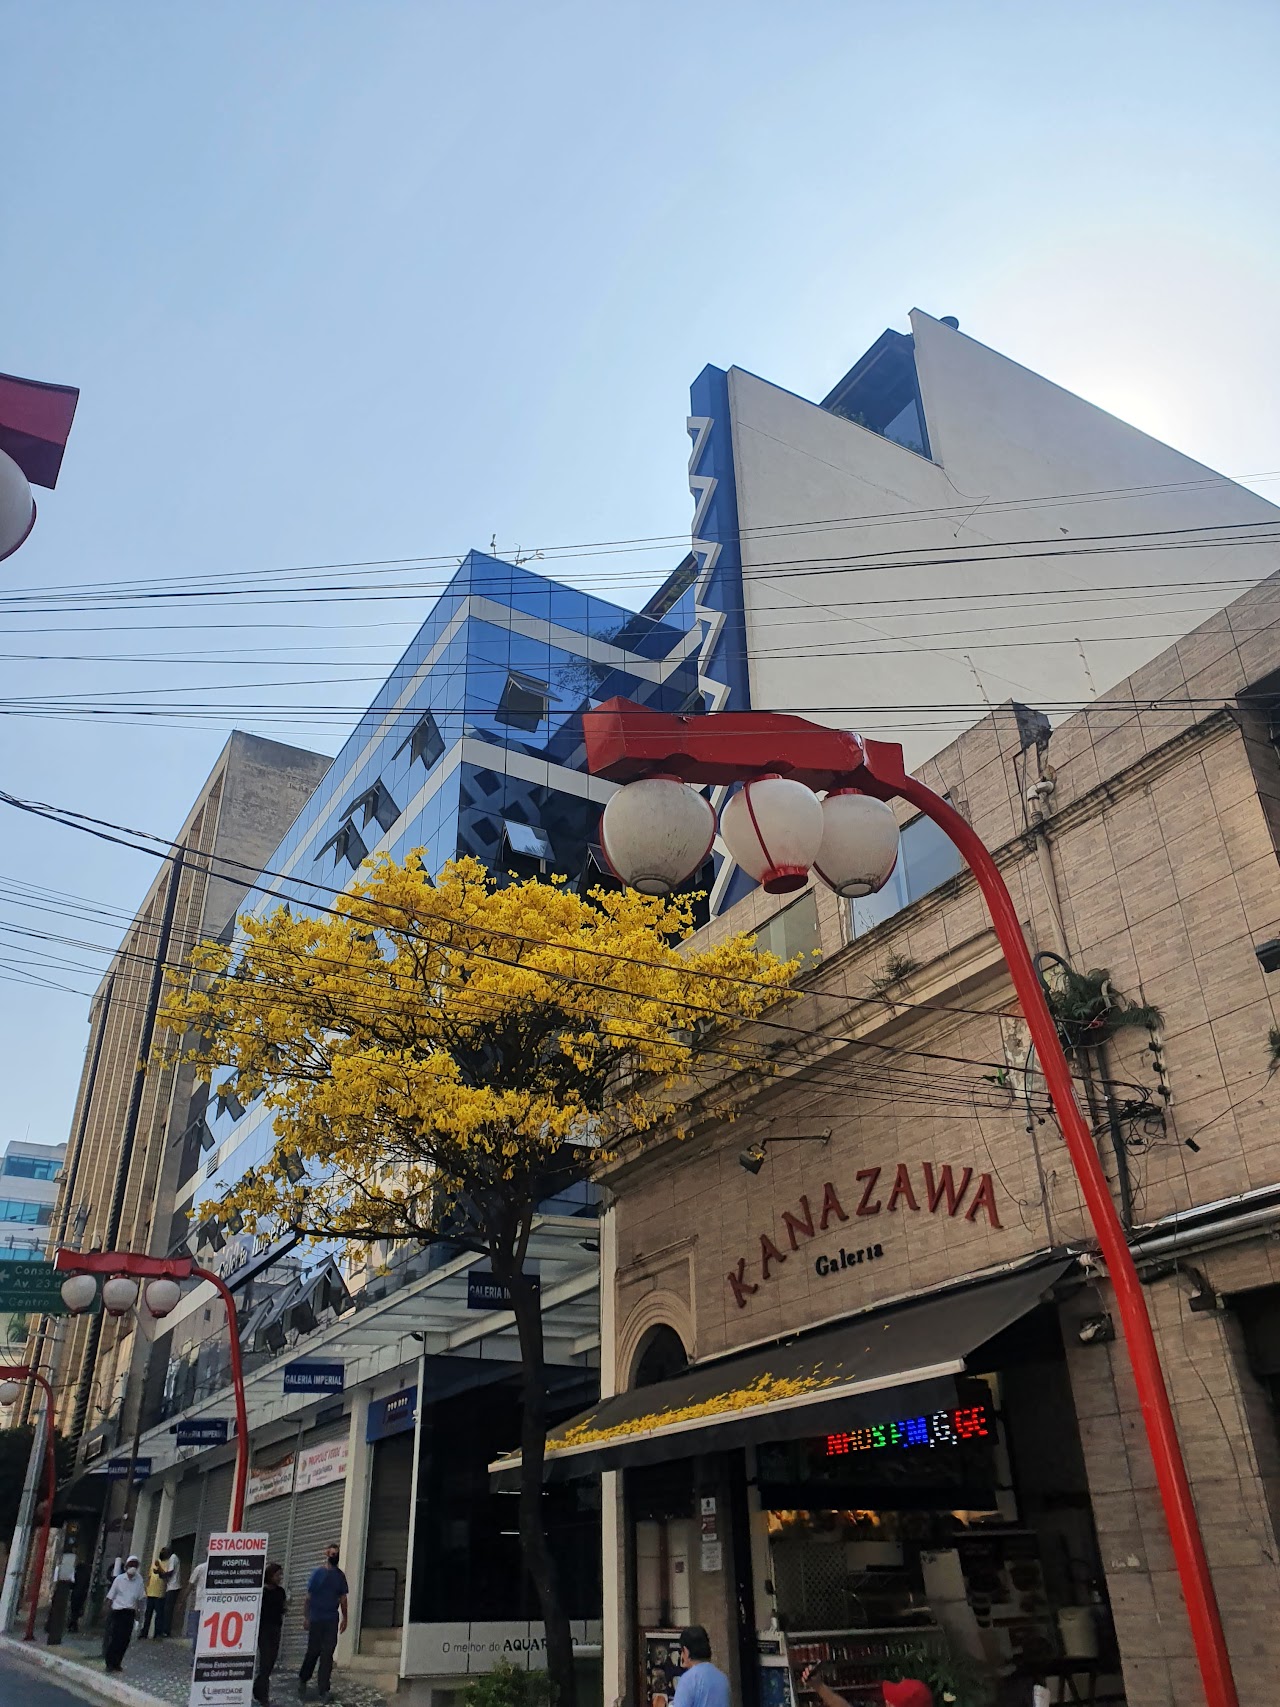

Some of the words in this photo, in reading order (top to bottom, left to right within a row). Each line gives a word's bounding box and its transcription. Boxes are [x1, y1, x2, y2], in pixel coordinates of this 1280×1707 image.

[728, 1161, 1004, 1308] KANAZAWA
[816, 1243, 884, 1276] Galeria
[36, 1279, 50, 1288] 23
[54, 1280, 61, 1288] d
[8, 1297, 50, 1307] Centro
[285, 1374, 312, 1385] GALERIA
[314, 1375, 342, 1386] IMPERIAL
[209, 1538, 267, 1551] ESTACIONE
[222, 1559, 250, 1567] HOSPITAL
[453, 1640, 485, 1653] melhor
